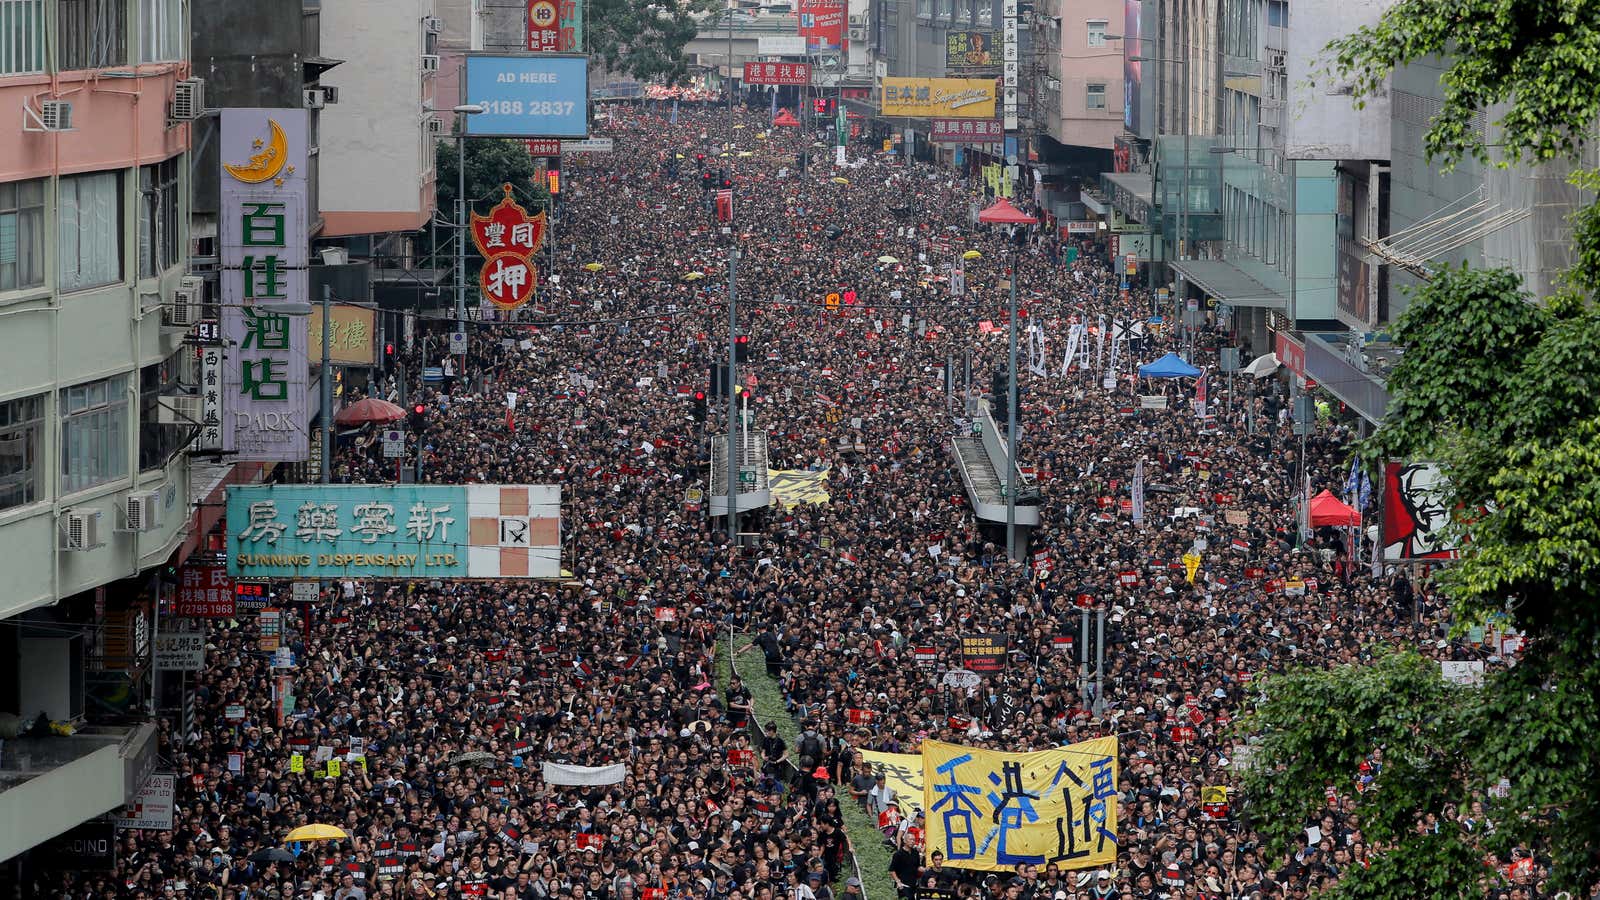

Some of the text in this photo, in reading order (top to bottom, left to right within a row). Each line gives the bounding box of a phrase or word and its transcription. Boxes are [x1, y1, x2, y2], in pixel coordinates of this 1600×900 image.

[497, 73, 557, 83] AD HERE
[886, 85, 930, 101] 日本城
[480, 101, 575, 115] 3188 2837
[487, 259, 527, 300] 押
[240, 203, 289, 400] 百佳酒店
[234, 411, 294, 432] PARK
[237, 554, 459, 566] SUNNING DISPENSARY LTD.
[183, 568, 229, 587] 許氏
[211, 604, 233, 614] 1968
